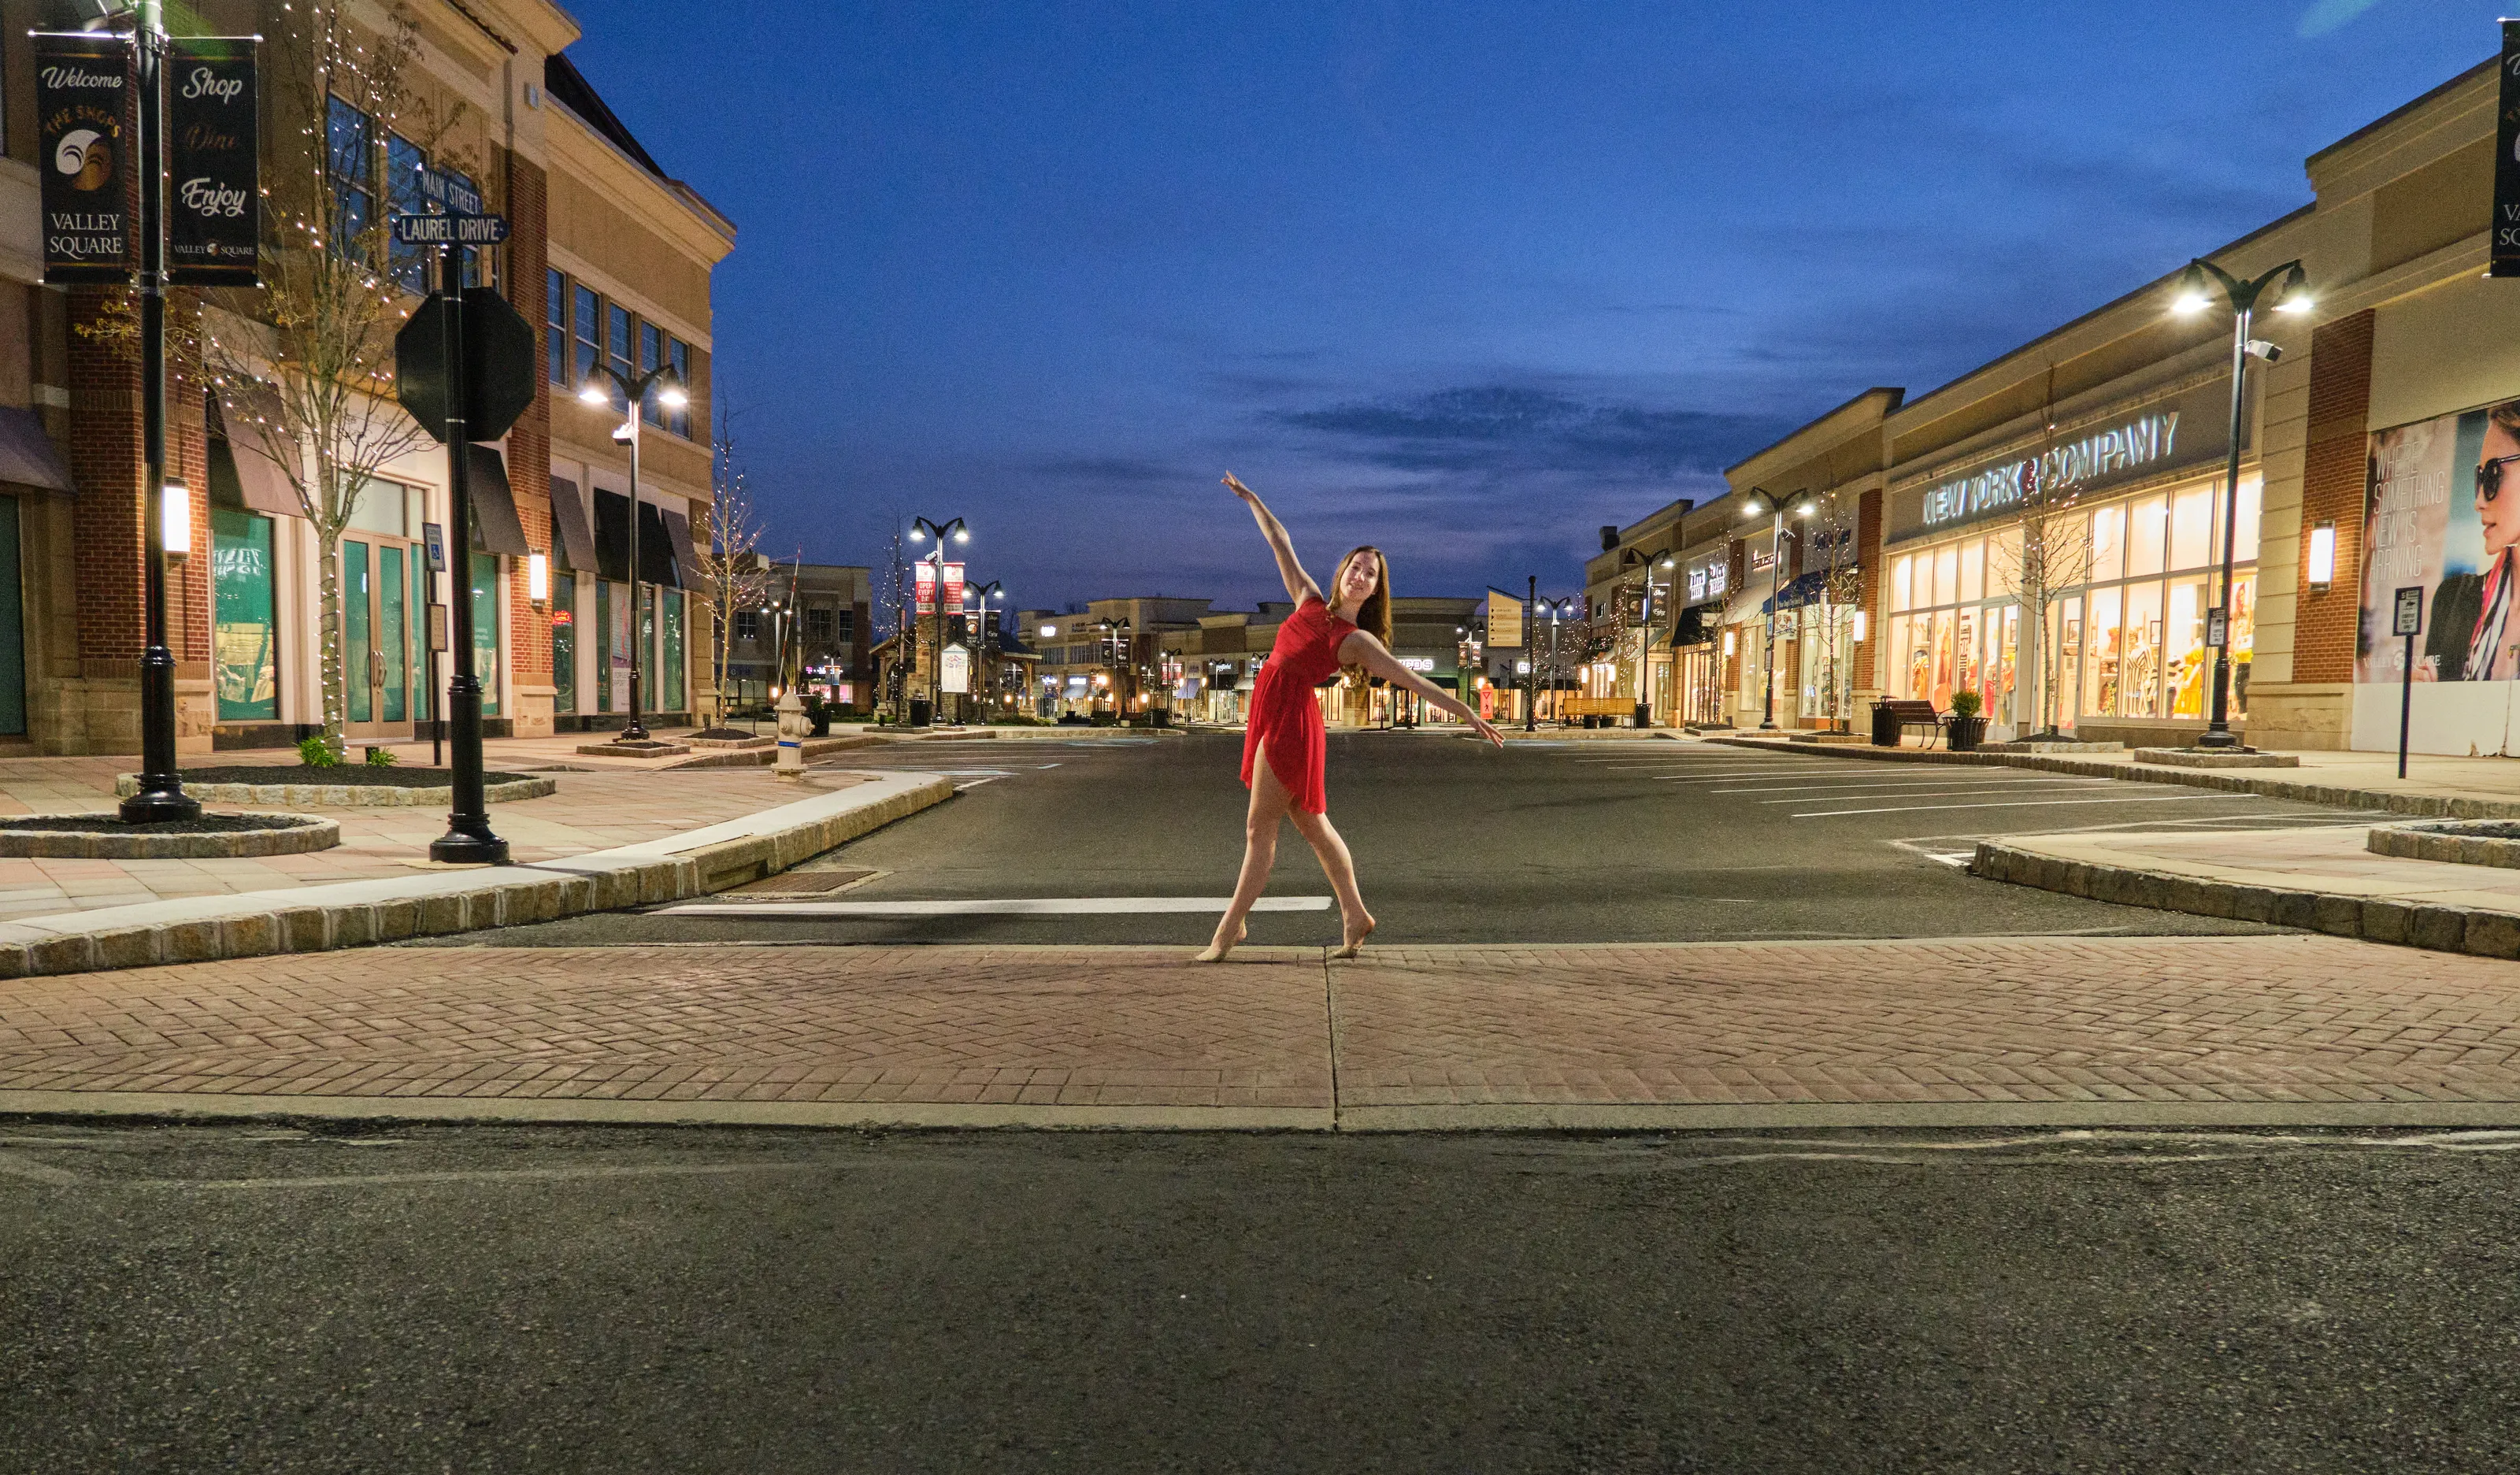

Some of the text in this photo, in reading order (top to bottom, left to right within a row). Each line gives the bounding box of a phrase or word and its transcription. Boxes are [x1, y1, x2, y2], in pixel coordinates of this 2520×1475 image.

[41, 66, 122, 90] Welcome
[182, 67, 243, 104] Shop
[181, 177, 246, 217] Enjoy
[423, 171, 479, 214] MAIN STREET
[50, 213, 120, 231] VALLEY
[402, 218, 499, 240] LAUREL DRIVE
[50, 236, 124, 260] SQUARE
[174, 245, 254, 258] VALLEY SQUARE
[1922, 479, 1967, 524] NEW
[1970, 460, 2024, 513] YORK
[2039, 411, 2180, 491] COMPANY
[2375, 441, 2421, 481] WHERE
[2374, 471, 2445, 515] SOMETHING
[2371, 510, 2418, 550] NEW IS
[2369, 544, 2422, 583] ARRIVING
[1653, 608, 1666, 617] Enjoy
[2412, 654, 2441, 669] QUARE
